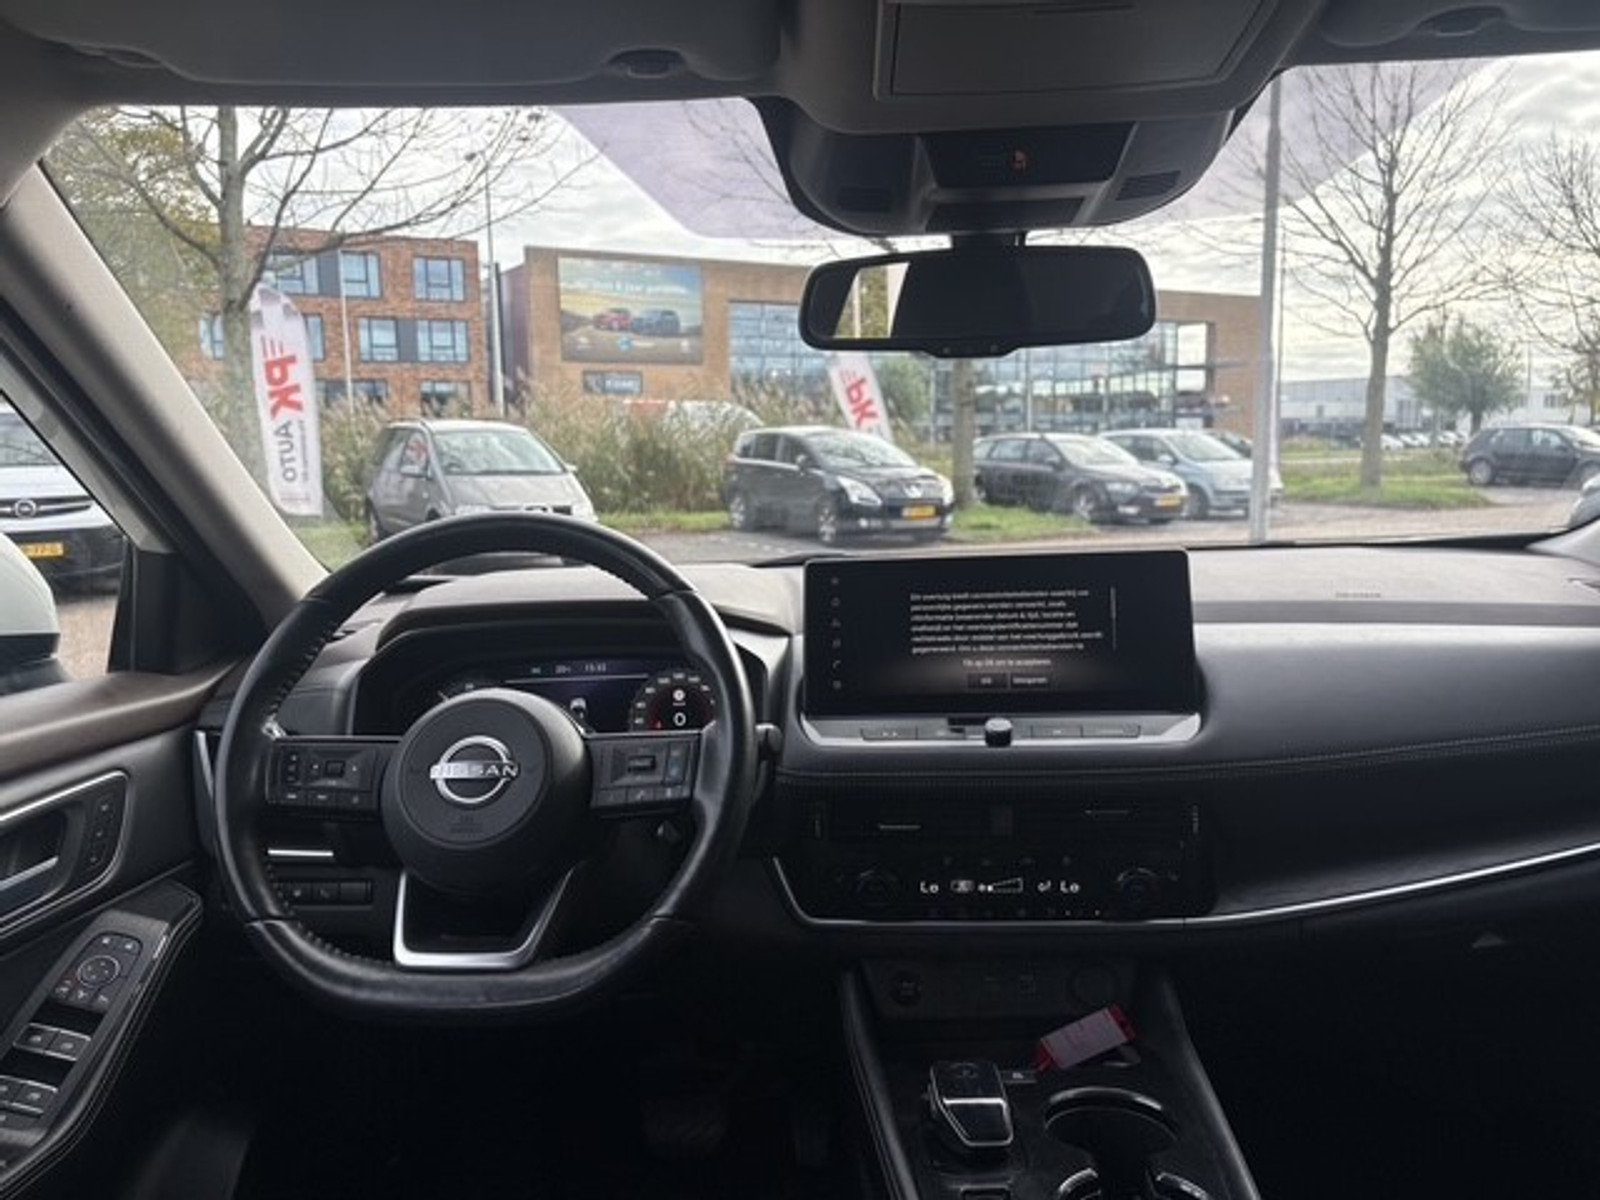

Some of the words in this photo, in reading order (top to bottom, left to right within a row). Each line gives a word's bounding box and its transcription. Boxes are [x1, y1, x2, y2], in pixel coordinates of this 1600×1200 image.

[430, 763, 518, 778] NISSAN
[919, 880, 940, 894] Lo
[1059, 880, 1080, 894] Lo
